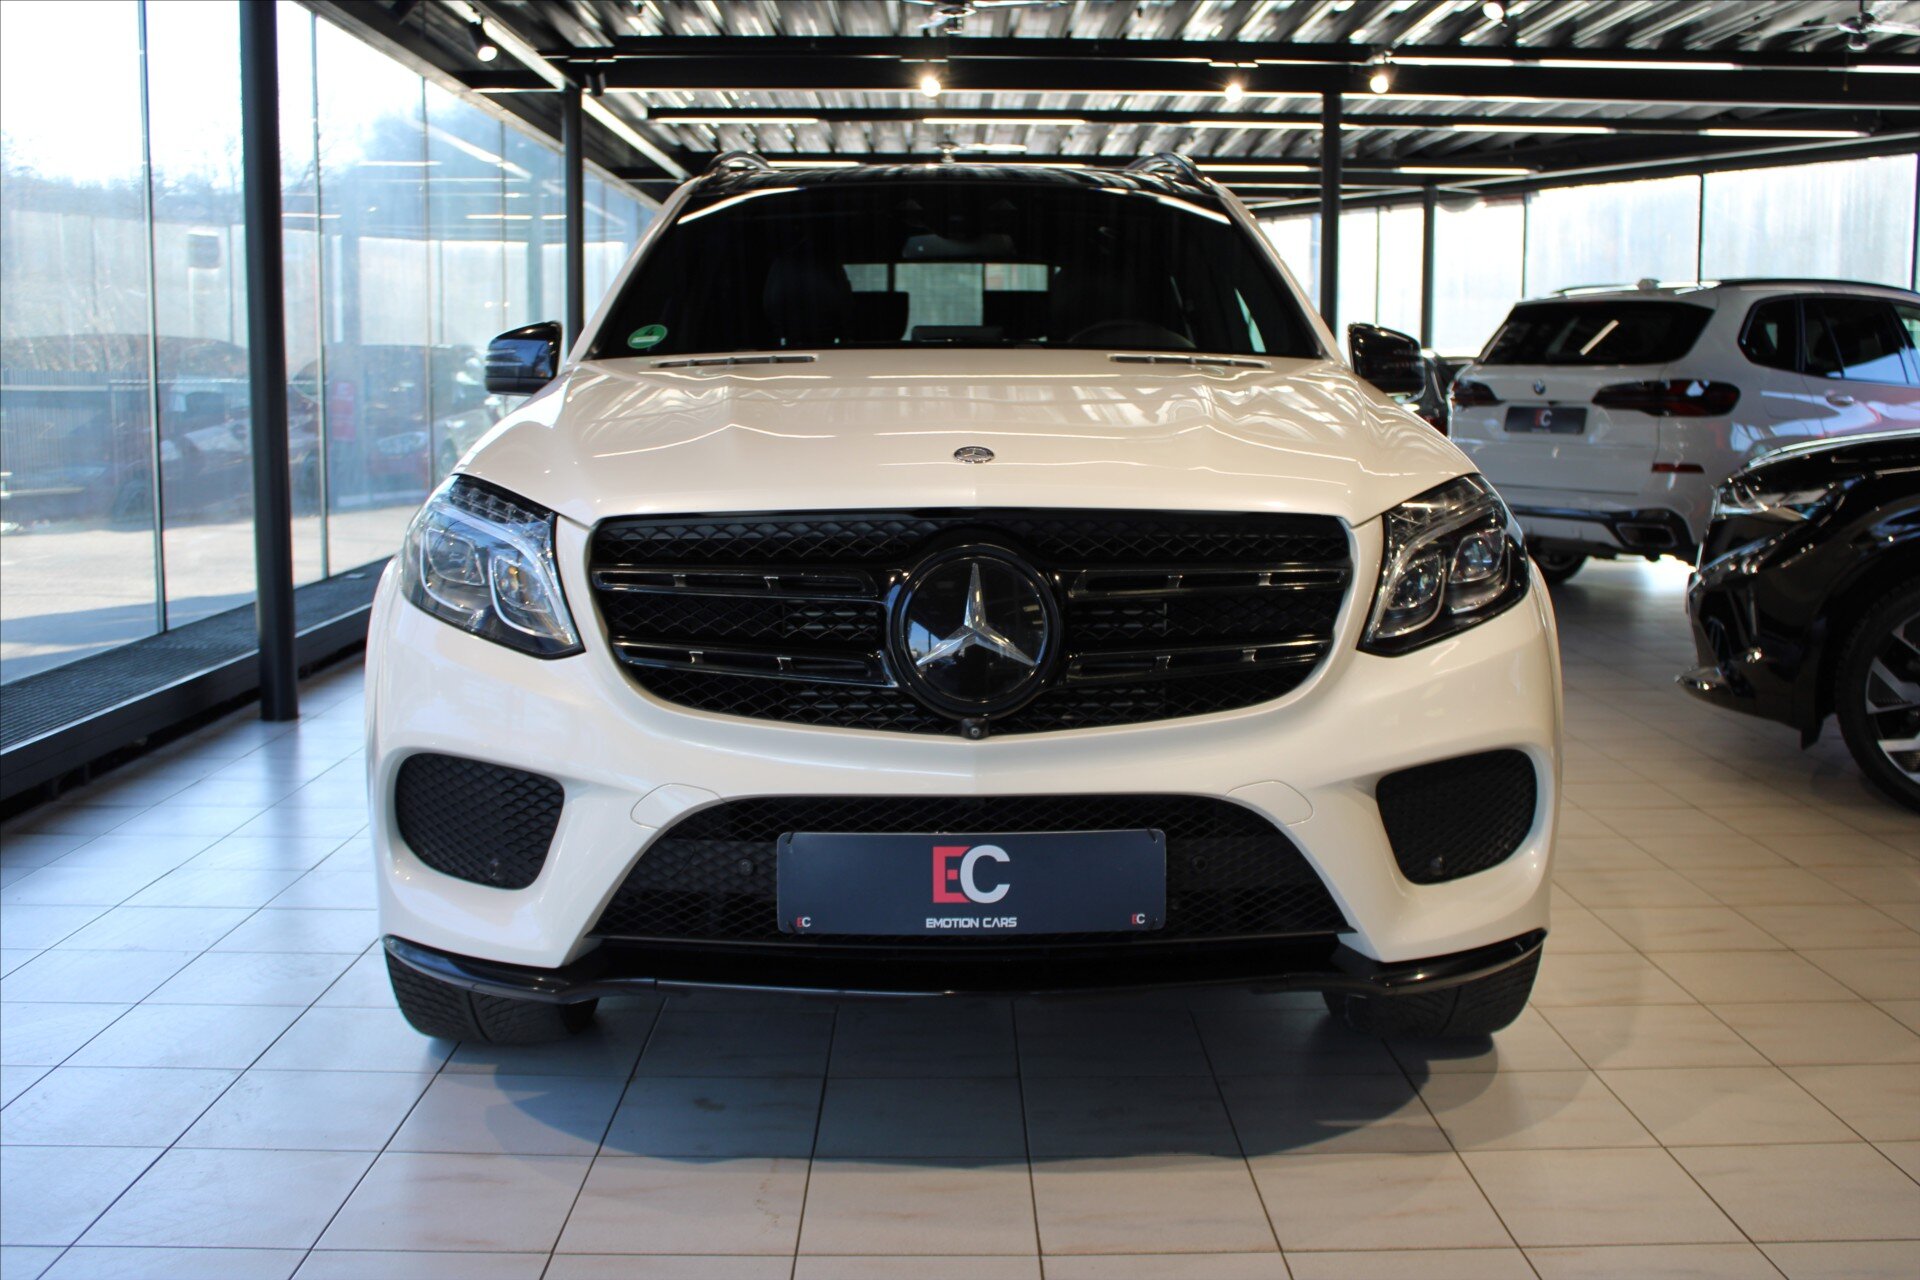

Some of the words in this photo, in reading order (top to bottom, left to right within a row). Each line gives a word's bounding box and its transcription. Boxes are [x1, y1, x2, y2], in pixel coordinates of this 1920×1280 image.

[933, 844, 1011, 904] EC
[925, 917, 980, 929] EMOTION
[982, 917, 1018, 928] CARS
